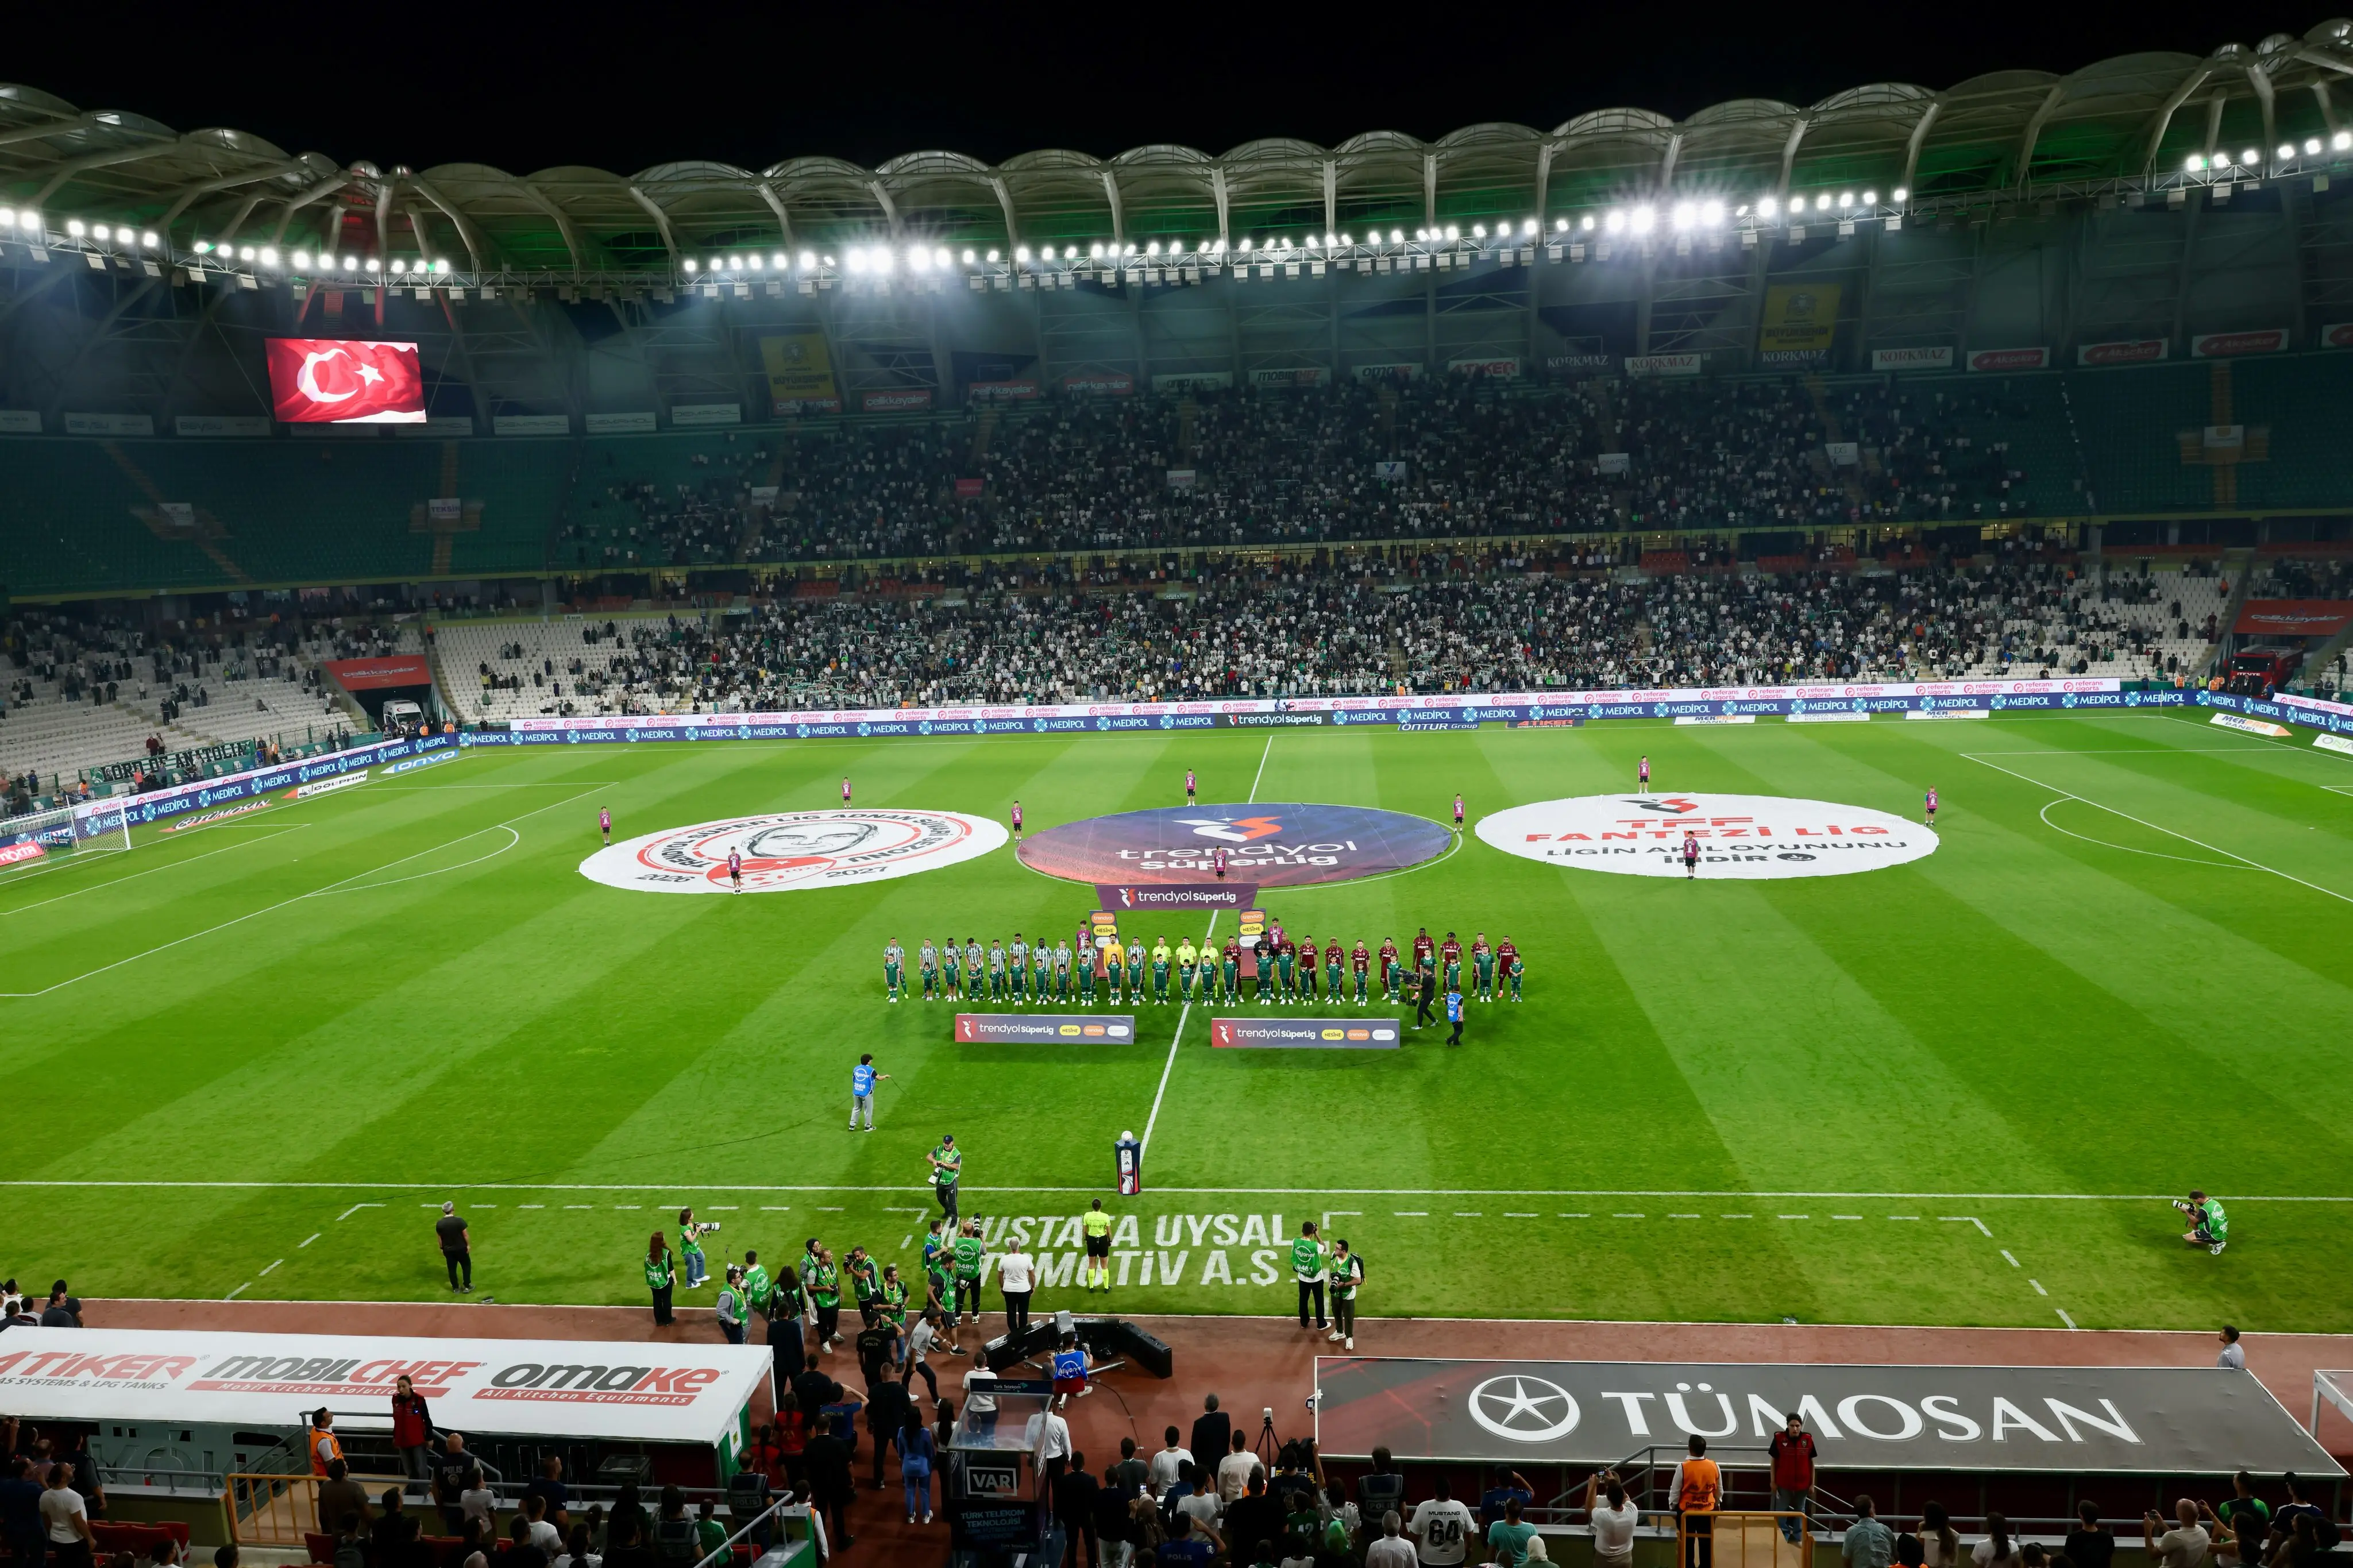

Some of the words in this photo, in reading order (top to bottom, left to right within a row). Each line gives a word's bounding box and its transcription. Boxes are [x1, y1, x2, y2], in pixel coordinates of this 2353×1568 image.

[1880, 348, 1946, 363] KORKMAZ
[1548, 356, 1608, 368] KORKMAZ
[1631, 356, 1694, 369] KORKMAZ
[1238, 715, 1284, 726] trendyol
[2224, 722, 2257, 732] PANEL
[101, 760, 145, 782] LORD
[148, 791, 173, 801] referans
[1616, 817, 1753, 828] TFF
[687, 820, 770, 839] SÜPER
[1116, 841, 1357, 859] trendyol
[1729, 841, 1908, 851] OYUNUNU
[635, 874, 696, 882] 2026
[825, 866, 889, 878] 2027
[1137, 890, 1192, 903] trendyol
[979, 1024, 1021, 1035] trendyol
[1237, 1028, 1280, 1040] trendyol
[1154, 1214, 1294, 1246] UYSAL
[15, 1378, 79, 1387] SYSTEMS
[121, 1382, 168, 1390] TANKS
[491, 1364, 721, 1393] omake
[218, 1382, 268, 1392] Mobil
[273, 1384, 333, 1394] Kitchen
[480, 1389, 507, 1397] All
[511, 1390, 578, 1400] Kitchen
[585, 1392, 689, 1404] Equipments
[1602, 1382, 2144, 1446] TÜMOSAN
[973, 1474, 1011, 1489] VAR
[961, 1511, 984, 1520] TÜRK
[985, 1509, 1025, 1518] TELEKOM
[1428, 1518, 1461, 1547] 64
